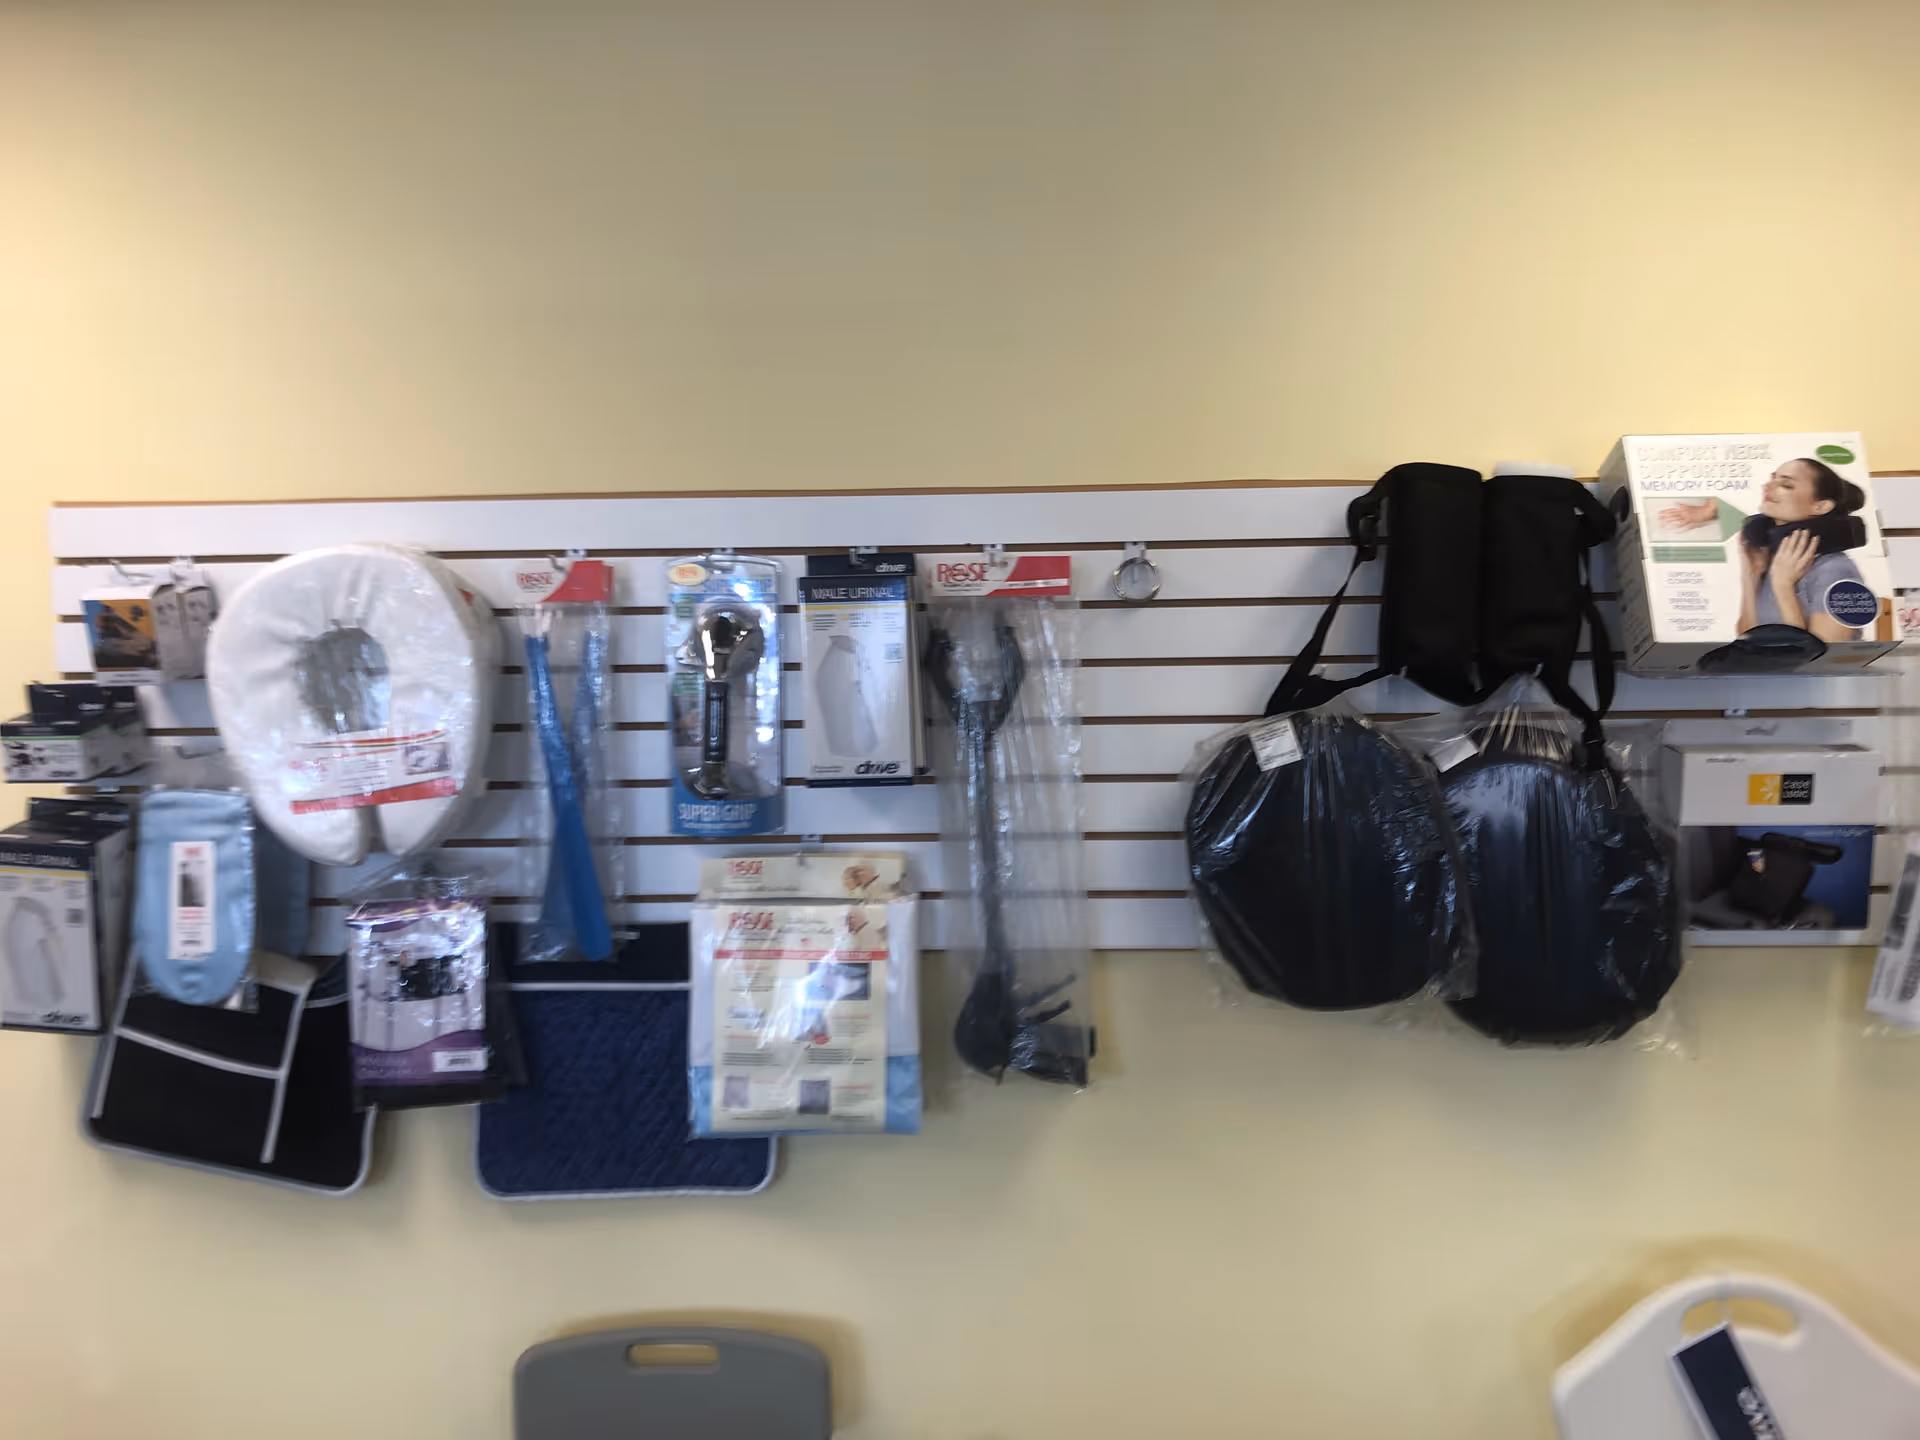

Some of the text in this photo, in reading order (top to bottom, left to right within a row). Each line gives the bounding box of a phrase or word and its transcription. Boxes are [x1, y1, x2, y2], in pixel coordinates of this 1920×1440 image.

[1640, 480, 1749, 491] MEMORY FOAM
[811, 587, 897, 600] MALE URINAL
[854, 760, 900, 775] drive
[1783, 780, 1810, 789] case
[678, 803, 719, 822] SUPER
